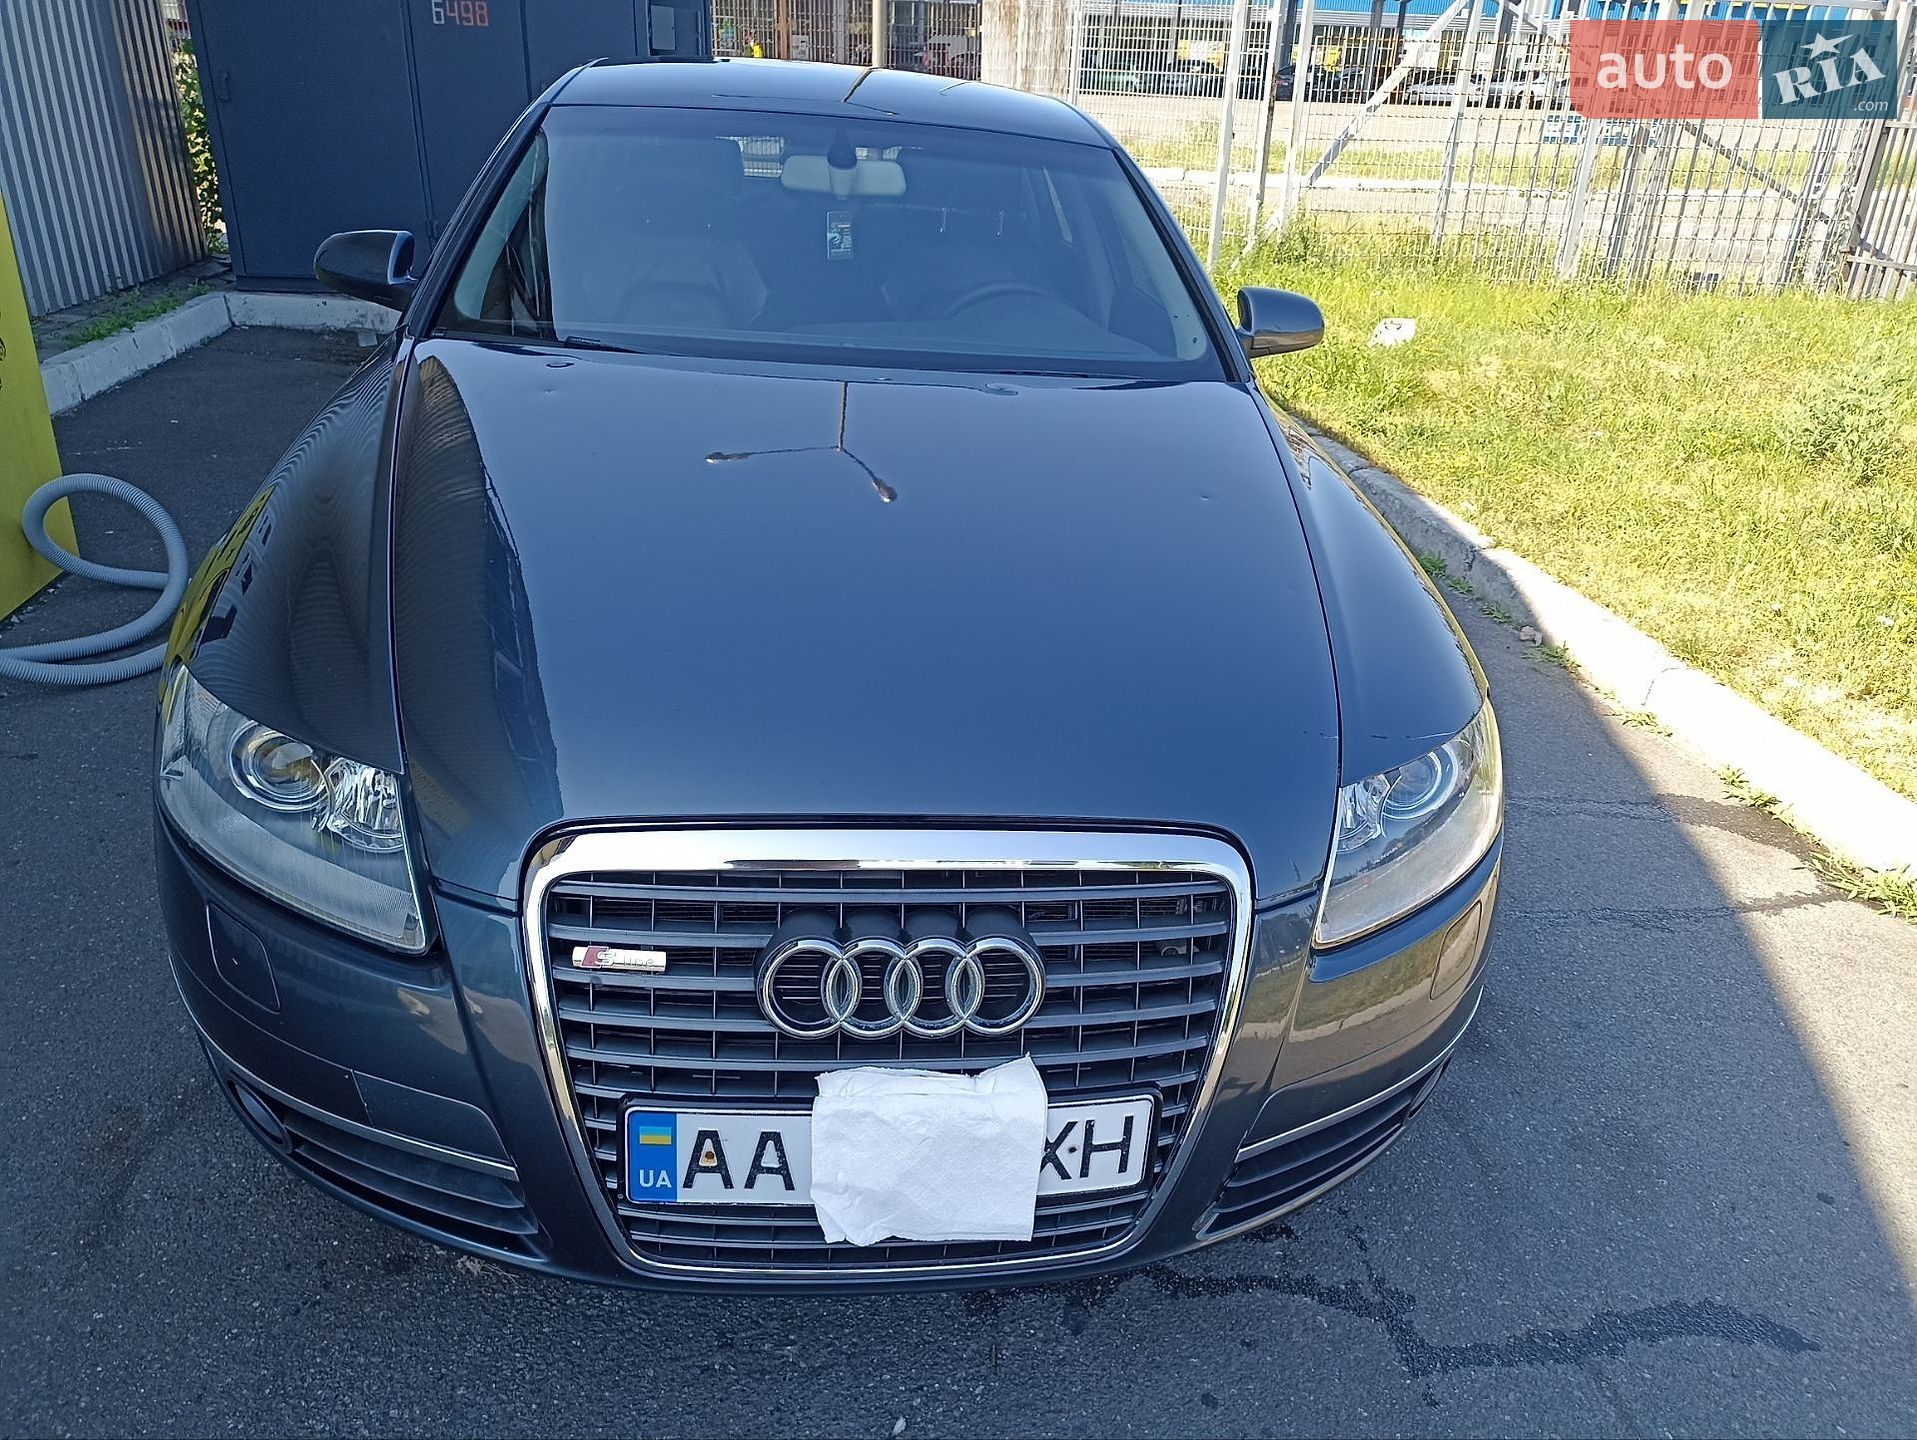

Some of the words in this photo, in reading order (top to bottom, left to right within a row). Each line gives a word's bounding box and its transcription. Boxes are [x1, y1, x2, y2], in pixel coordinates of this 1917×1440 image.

[431, 0, 489, 26] 6498
[682, 1129, 796, 1191] AA
[639, 1169, 672, 1188] UA
